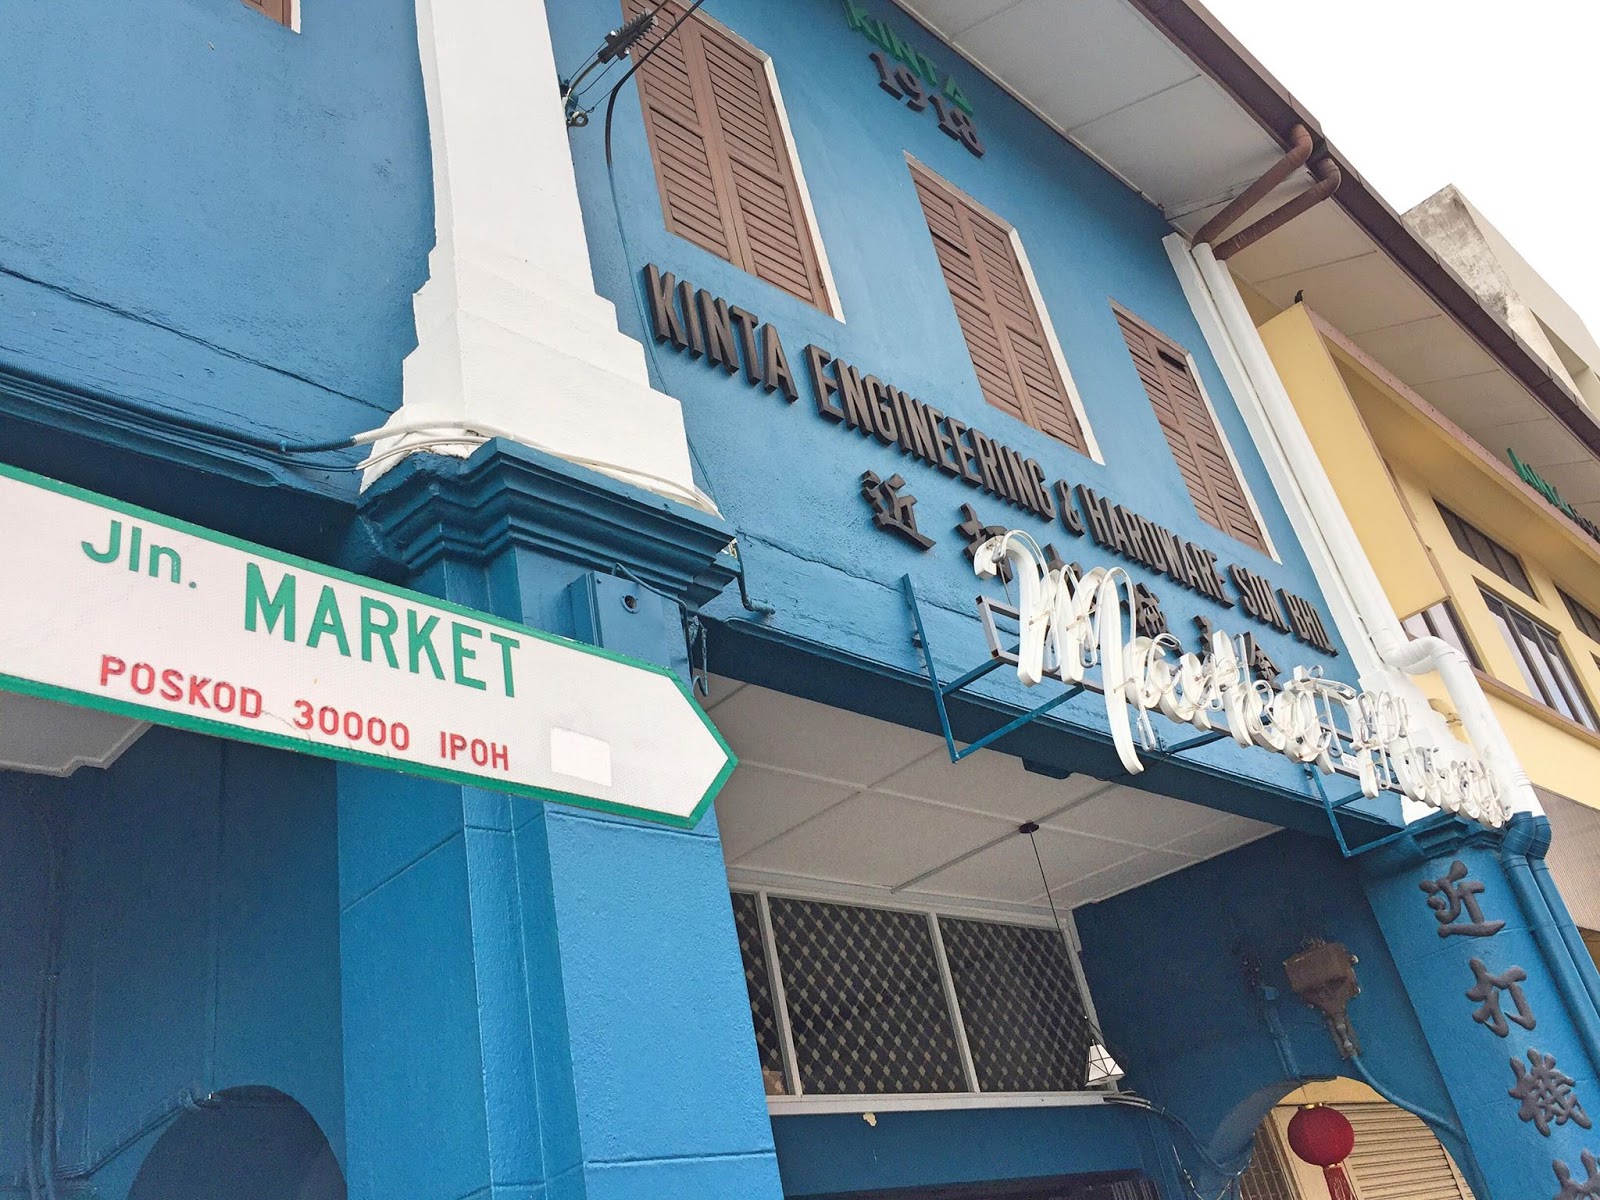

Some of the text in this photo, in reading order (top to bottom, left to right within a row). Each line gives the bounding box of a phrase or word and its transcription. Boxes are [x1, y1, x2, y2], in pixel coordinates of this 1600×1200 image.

[842, 0, 974, 118] KINTA
[868, 52, 987, 159] 1918
[643, 262, 799, 404] KINTA
[804, 343, 1054, 522] ENGINEERING
[1054, 479, 1085, 537] &
[1076, 483, 1235, 609] HARDWARE
[81, 519, 520, 699] Jln. MARKET
[100, 654, 509, 772] POSKOD 30000 IPOH
